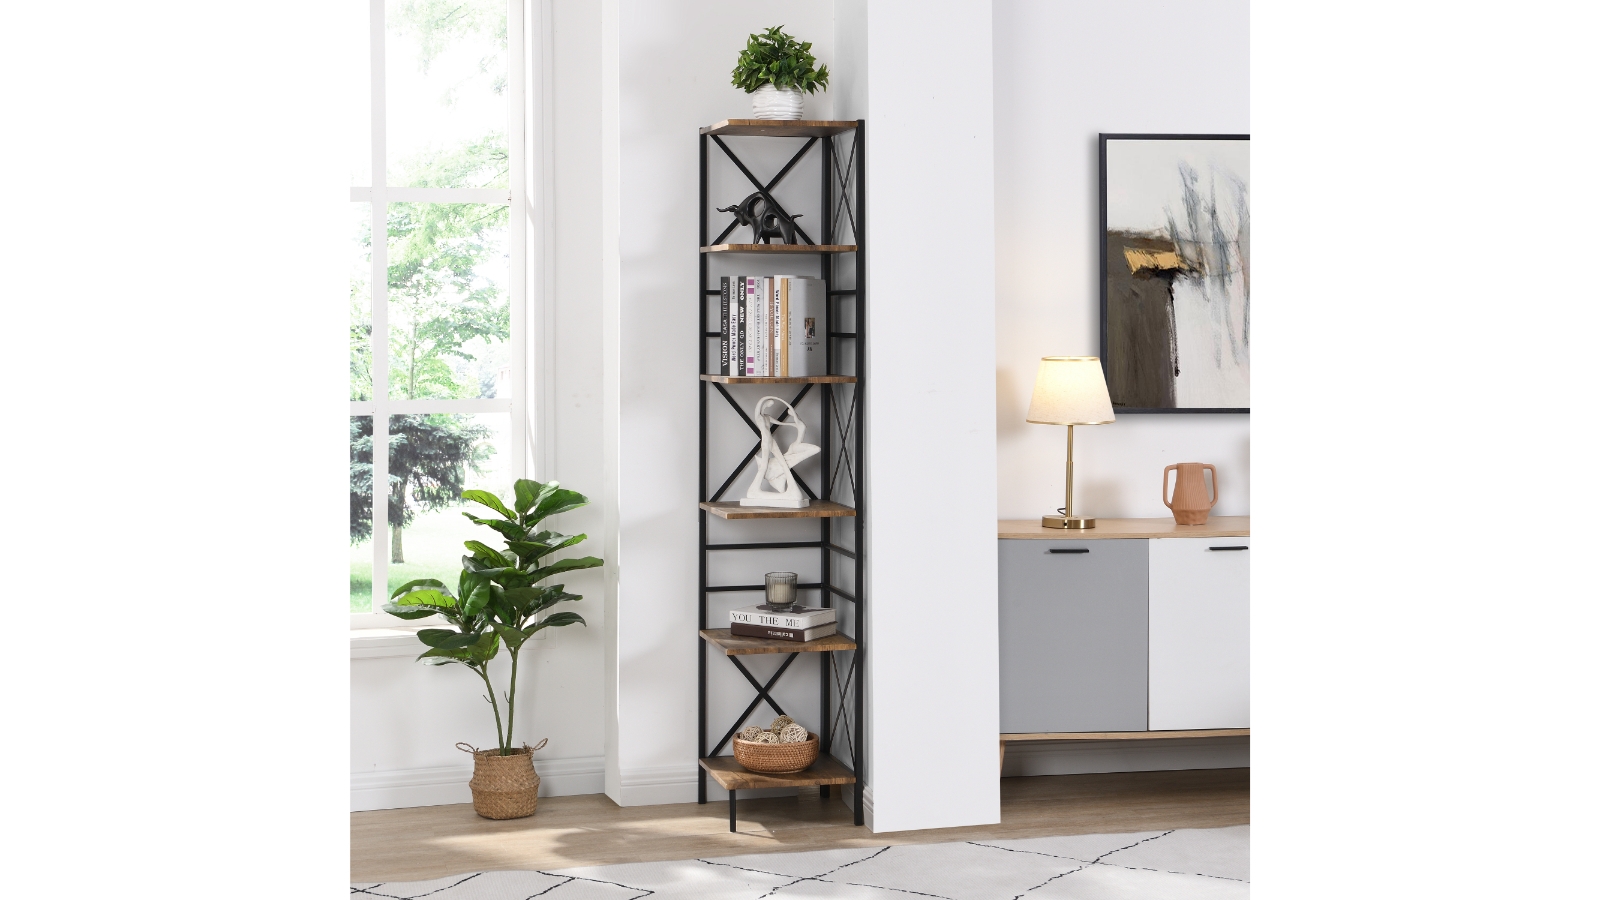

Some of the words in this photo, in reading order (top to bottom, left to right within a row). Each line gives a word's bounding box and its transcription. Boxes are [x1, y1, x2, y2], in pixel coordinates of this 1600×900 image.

[731, 612, 752, 623] YOU
[758, 615, 779, 626] THE
[785, 618, 800, 628] ME
